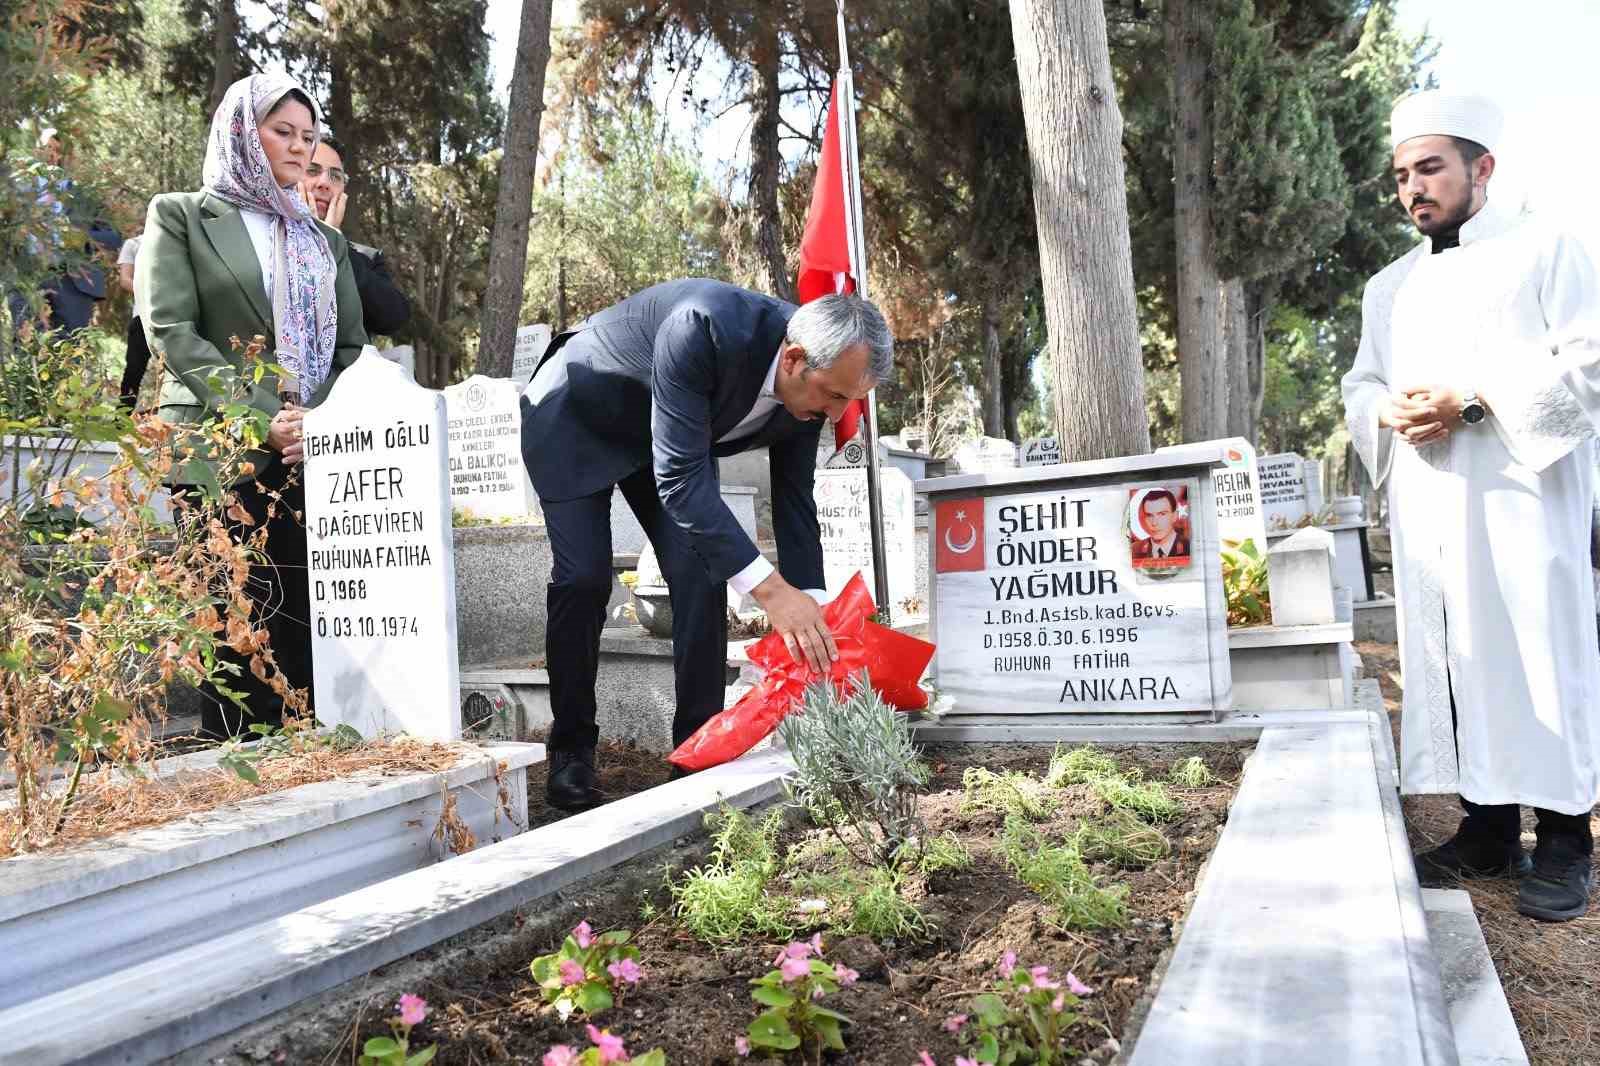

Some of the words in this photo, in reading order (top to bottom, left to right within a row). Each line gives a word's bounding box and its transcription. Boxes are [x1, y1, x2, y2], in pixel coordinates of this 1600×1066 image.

[306, 426, 374, 457] İBRAHİM
[385, 420, 430, 449] OĞLU
[449, 457, 463, 471] DA
[327, 467, 404, 504] ZAFER
[1216, 491, 1253, 507] ATİHA
[318, 507, 424, 538] DAĞDEVİREN
[998, 496, 1090, 537] ŞEHİT
[311, 545, 373, 571] RUHUNA
[376, 540, 431, 569] FATİHA
[996, 536, 1098, 567] ÖNDER
[990, 568, 1119, 601] YAĞMUR
[317, 611, 418, 638] Ö.03.10.1974
[993, 655, 1052, 673] RUHUNA
[1073, 650, 1131, 670] FATİHA
[1059, 676, 1181, 704] ANKARA
